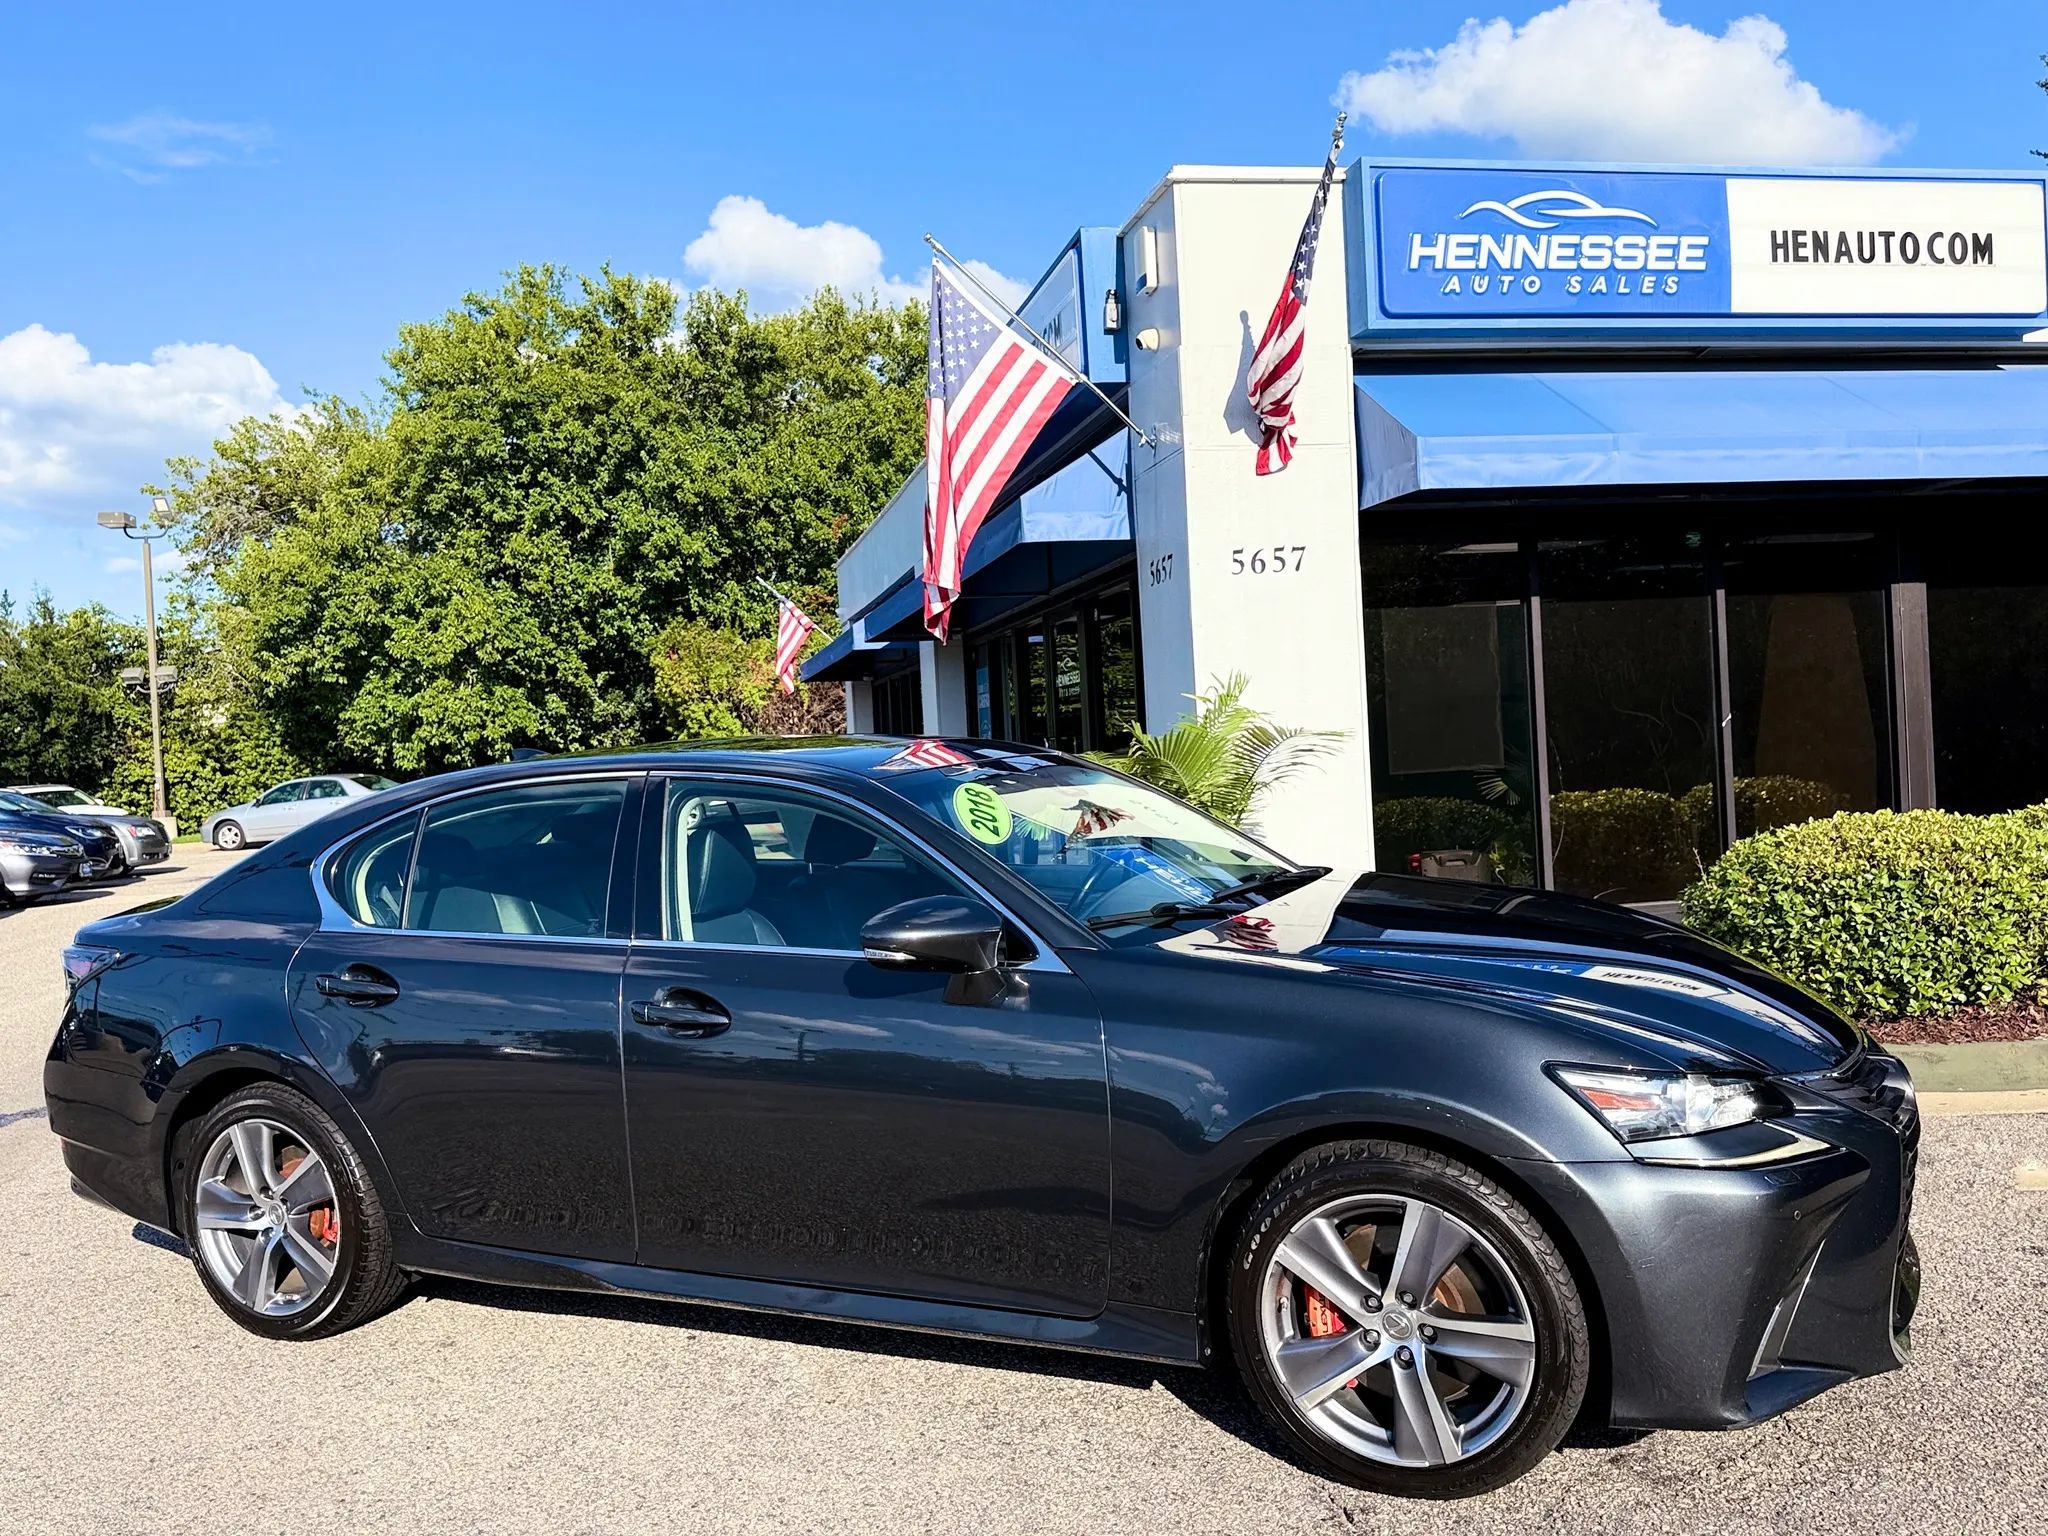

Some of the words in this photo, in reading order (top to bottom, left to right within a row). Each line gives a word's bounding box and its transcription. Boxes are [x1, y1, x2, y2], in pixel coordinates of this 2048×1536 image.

[1408, 233, 1709, 270] HENNESSEE
[1441, 275, 1542, 294] AUTO
[1566, 275, 1680, 294] SALES
[1150, 553, 1173, 587] 5657
[1230, 545, 1306, 575] 5657
[964, 787, 1000, 837] 2018
